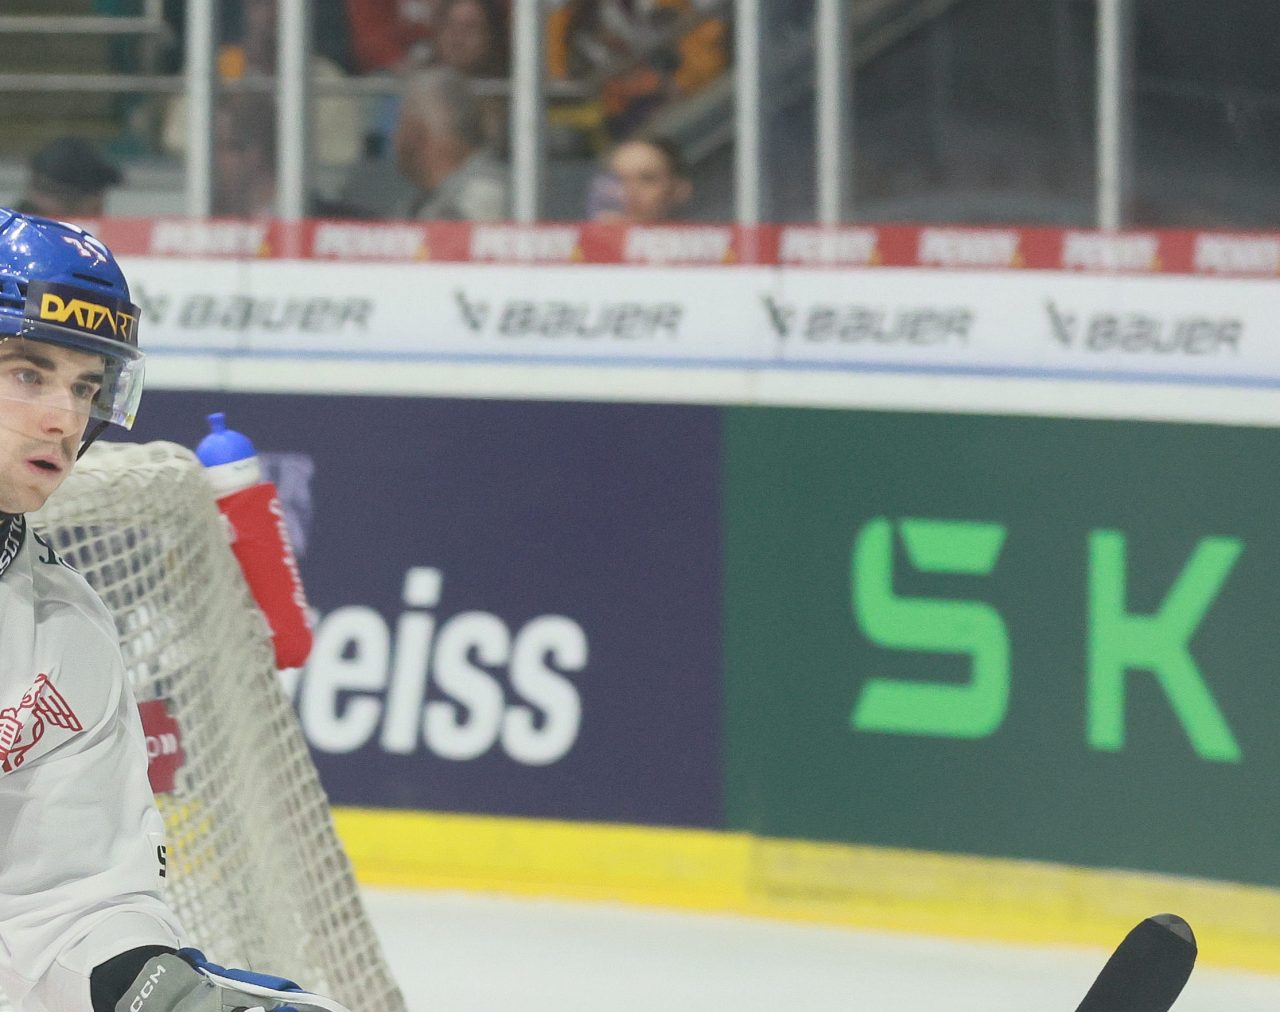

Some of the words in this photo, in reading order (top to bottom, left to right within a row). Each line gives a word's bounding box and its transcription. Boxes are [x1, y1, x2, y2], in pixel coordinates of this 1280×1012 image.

[179, 296, 372, 335] BAUER
[498, 299, 681, 339] BAUER
[805, 303, 974, 344] BAUER
[1086, 312, 1242, 354] BAUER
[299, 566, 588, 766] eiss
